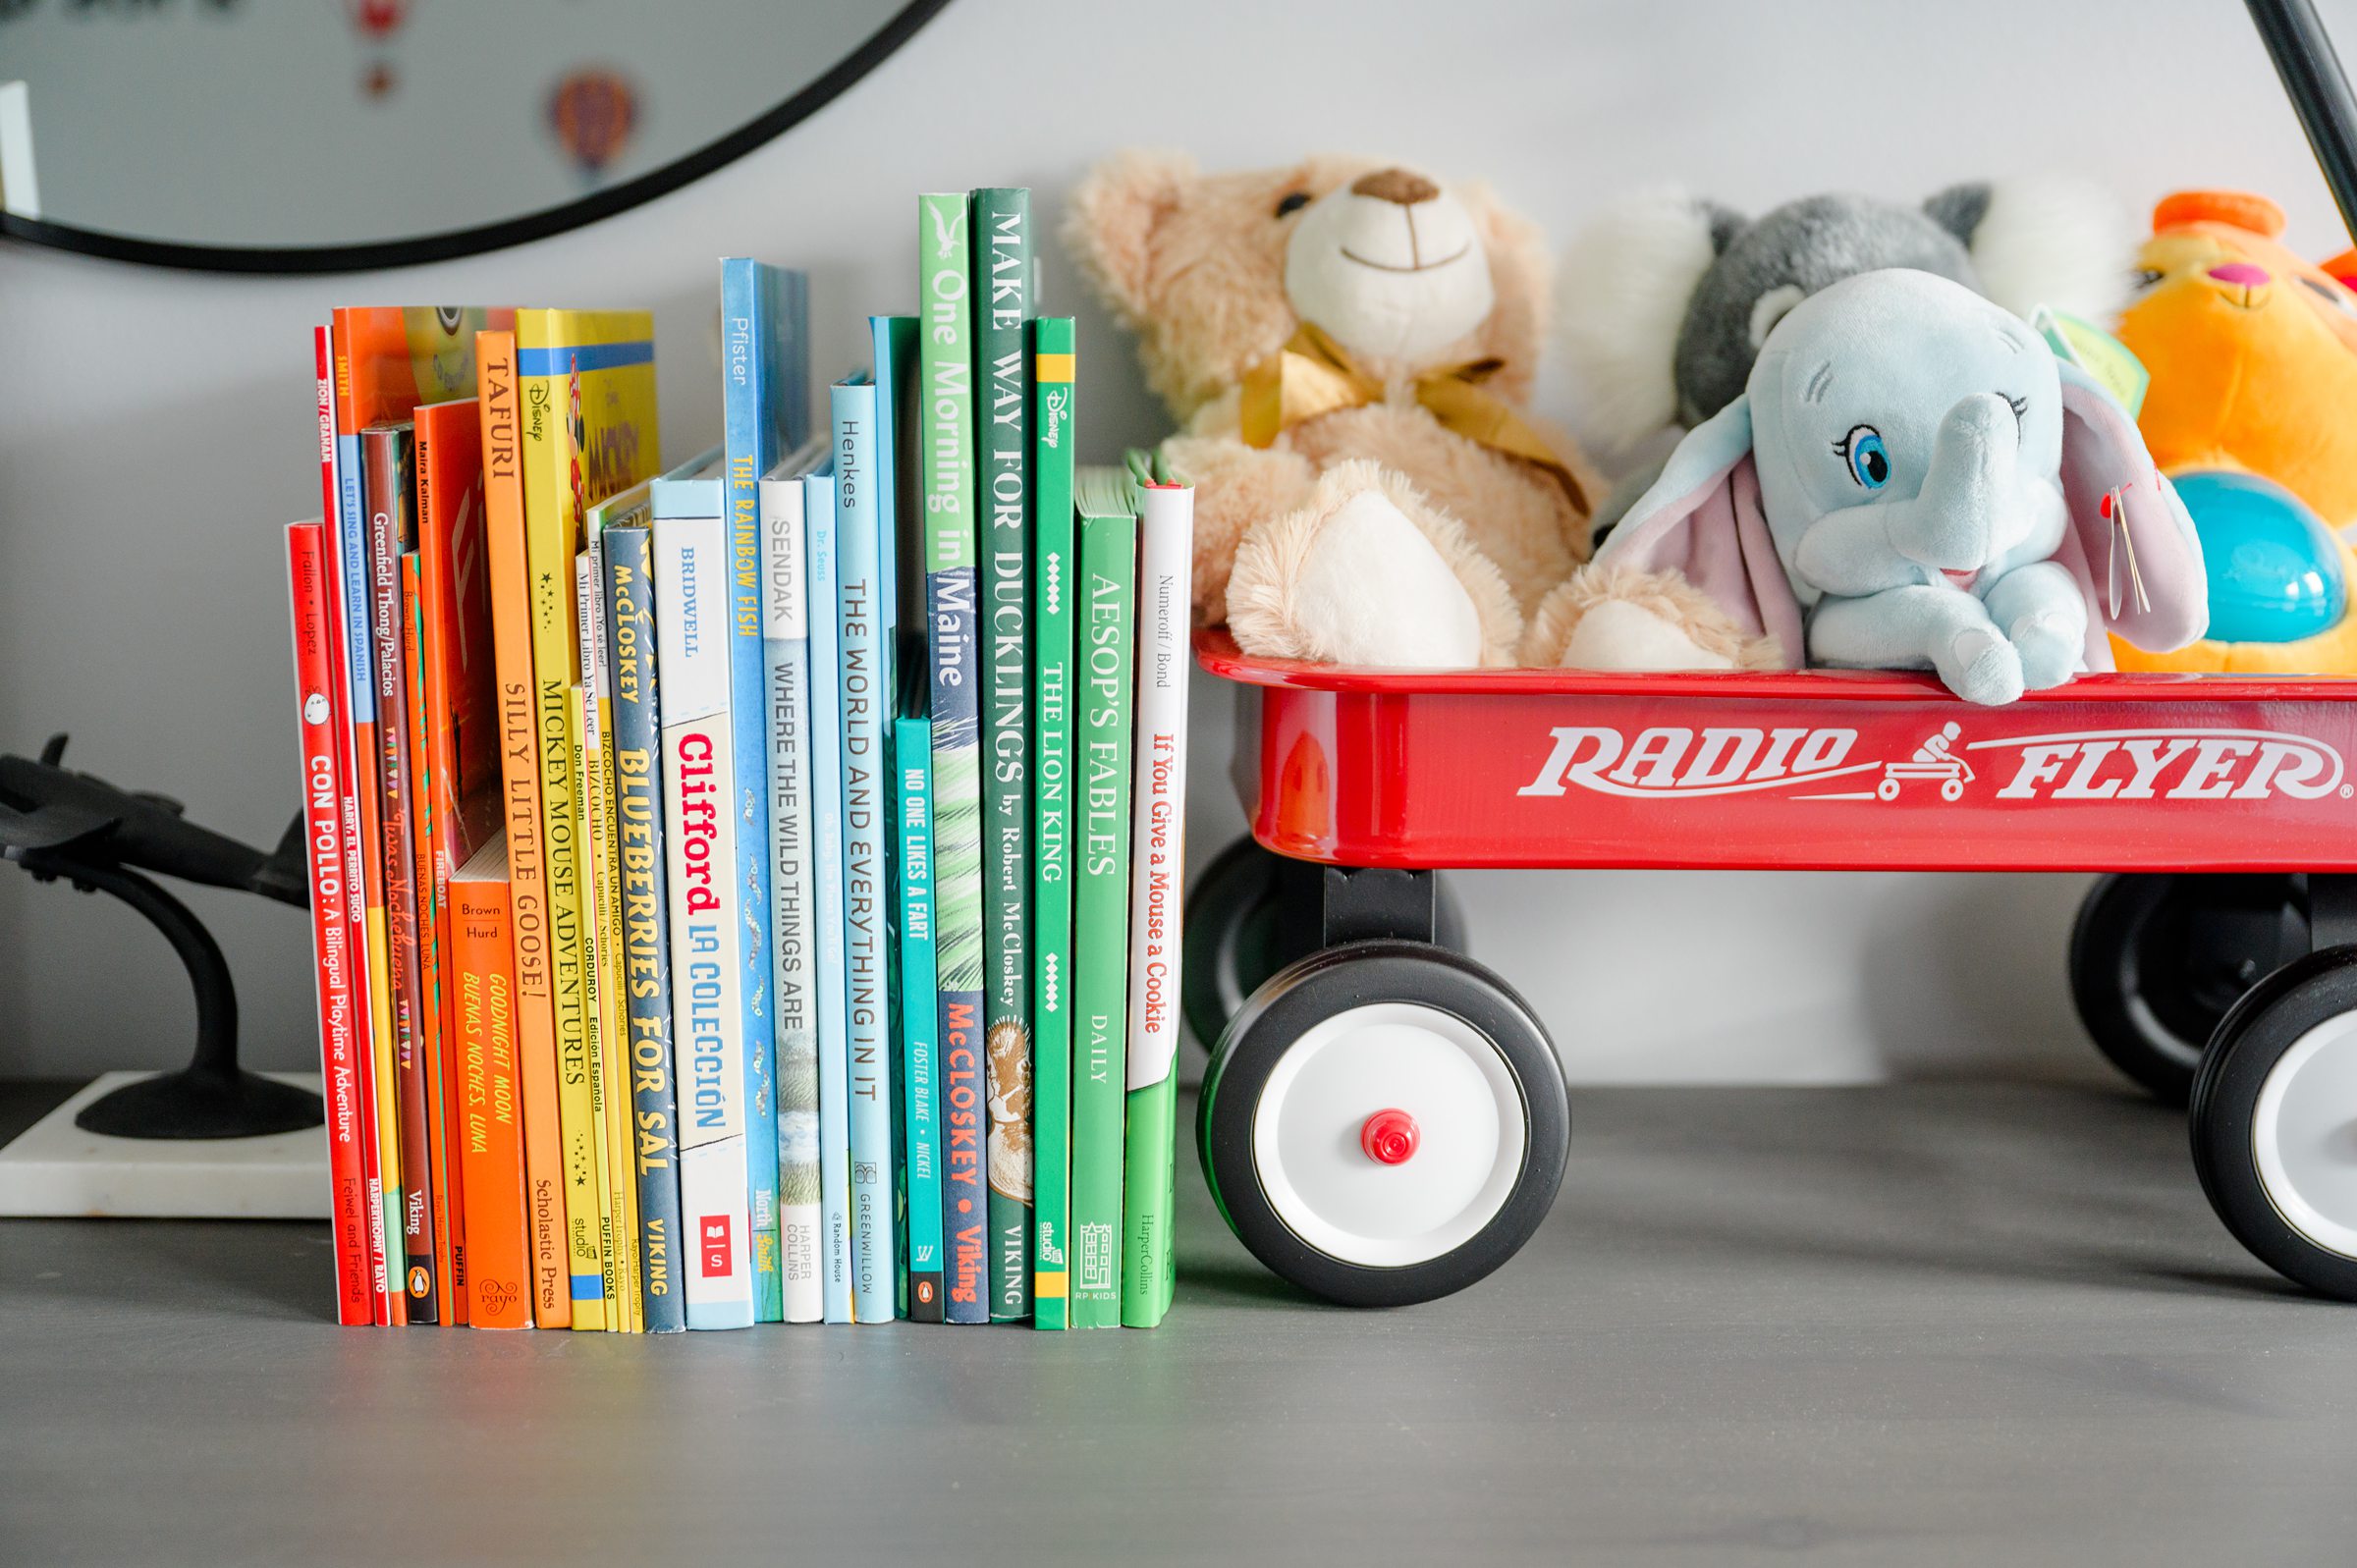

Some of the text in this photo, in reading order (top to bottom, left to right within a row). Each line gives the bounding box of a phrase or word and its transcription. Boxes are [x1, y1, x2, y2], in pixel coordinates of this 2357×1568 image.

[338, 354, 349, 397] SMITH
[732, 317, 748, 386] Pfister
[317, 378, 332, 462] ZION GRAHAM
[486, 357, 515, 479] TAFURI
[842, 420, 860, 509] Henkes
[927, 269, 969, 561] One Morning in
[418, 441, 429, 524] Maira Kalman
[302, 551, 318, 656] Fallon Lopez
[348, 510, 366, 681] SING AND LEARN IN SPANISH
[590, 541, 607, 668] Mi primer libro leer!
[682, 547, 698, 658] BRIDWELL
[733, 455, 758, 637] THE RAINBOW FISH
[772, 519, 793, 622] SENDAK
[817, 530, 826, 582] Dr. Seuss
[374, 514, 397, 697] Greenfield Thong/Palacios
[578, 573, 597, 735] Mi Primer Libro Ya Leer
[614, 565, 639, 704] McCLOSKEY
[936, 576, 970, 686] Maine
[992, 211, 1024, 1006] MAKE WAY FOR DUCKLINGS by Robert McCloskey
[1157, 575, 1174, 688] Numeroff Bond
[1043, 662, 1063, 883] THE LION KING
[1087, 572, 1121, 875] AESOP'S FABLES
[1516, 727, 2345, 800] RADIO FLYER
[505, 683, 547, 998] SILLY LITTLE GOOSE!
[574, 745, 585, 821] Don Freeman
[589, 760, 603, 841] BIZCOCHO
[602, 731, 622, 936] BIZCOCHO ENCUENTRA UN AMIGO
[678, 732, 721, 916] Clifford
[845, 578, 876, 1101] THE WORLD AND EVERYTHING IN IT
[344, 796, 361, 923] HARRY, EL PERRITO SUCIO
[436, 850, 447, 909] FIREBOAT
[543, 679, 585, 1086] MICKEY MOUSE ADVENTURES
[774, 662, 803, 1030] WHERE THE WILD THINGS ARE
[904, 769, 928, 941] NO ONE LIKES A FART
[1145, 733, 1174, 1034] If You Give a Mouse a Cookie
[311, 755, 355, 1143] CON POLLO: A Bilingual Playtime Adventure
[385, 870, 417, 990] Nochebuena
[416, 853, 431, 970] BUENAS LUNA
[462, 903, 501, 915] Brown
[466, 927, 498, 939] Hurd
[619, 748, 669, 1176] BLUEBERRIES FOR SAL
[463, 971, 487, 1153] BUENAS LUNA
[490, 972, 513, 1124] GOODNIGHT MOON
[584, 938, 602, 1112] CORDUROY Edición Española
[688, 924, 726, 1128] LA COLECCIÓN
[1091, 1014, 1108, 1084] DAILY
[914, 1041, 931, 1179] FOSTER BLAKE NICKEL
[948, 1002, 982, 1304] McCLOSKEY Viking
[344, 1178, 362, 1304] Feiwel and Friends
[369, 1178, 386, 1293] HARPERTROPHY RAYO
[407, 1190, 424, 1235] Viking
[455, 1246, 465, 1286] PUFFIN
[536, 1179, 557, 1309] Scholastic Press
[602, 1217, 615, 1300] PUFFIN BOOKS
[647, 1218, 669, 1297] VIKING
[755, 1189, 773, 1227] North
[787, 1224, 799, 1281] COLLINS
[799, 1225, 812, 1279] HARPER
[833, 1222, 843, 1283] Random House
[860, 1194, 872, 1294] GREENWILLOW
[1005, 1225, 1022, 1305] VIKING
[1042, 1221, 1056, 1262] studio
[1139, 1215, 1154, 1295] HarperCollins
